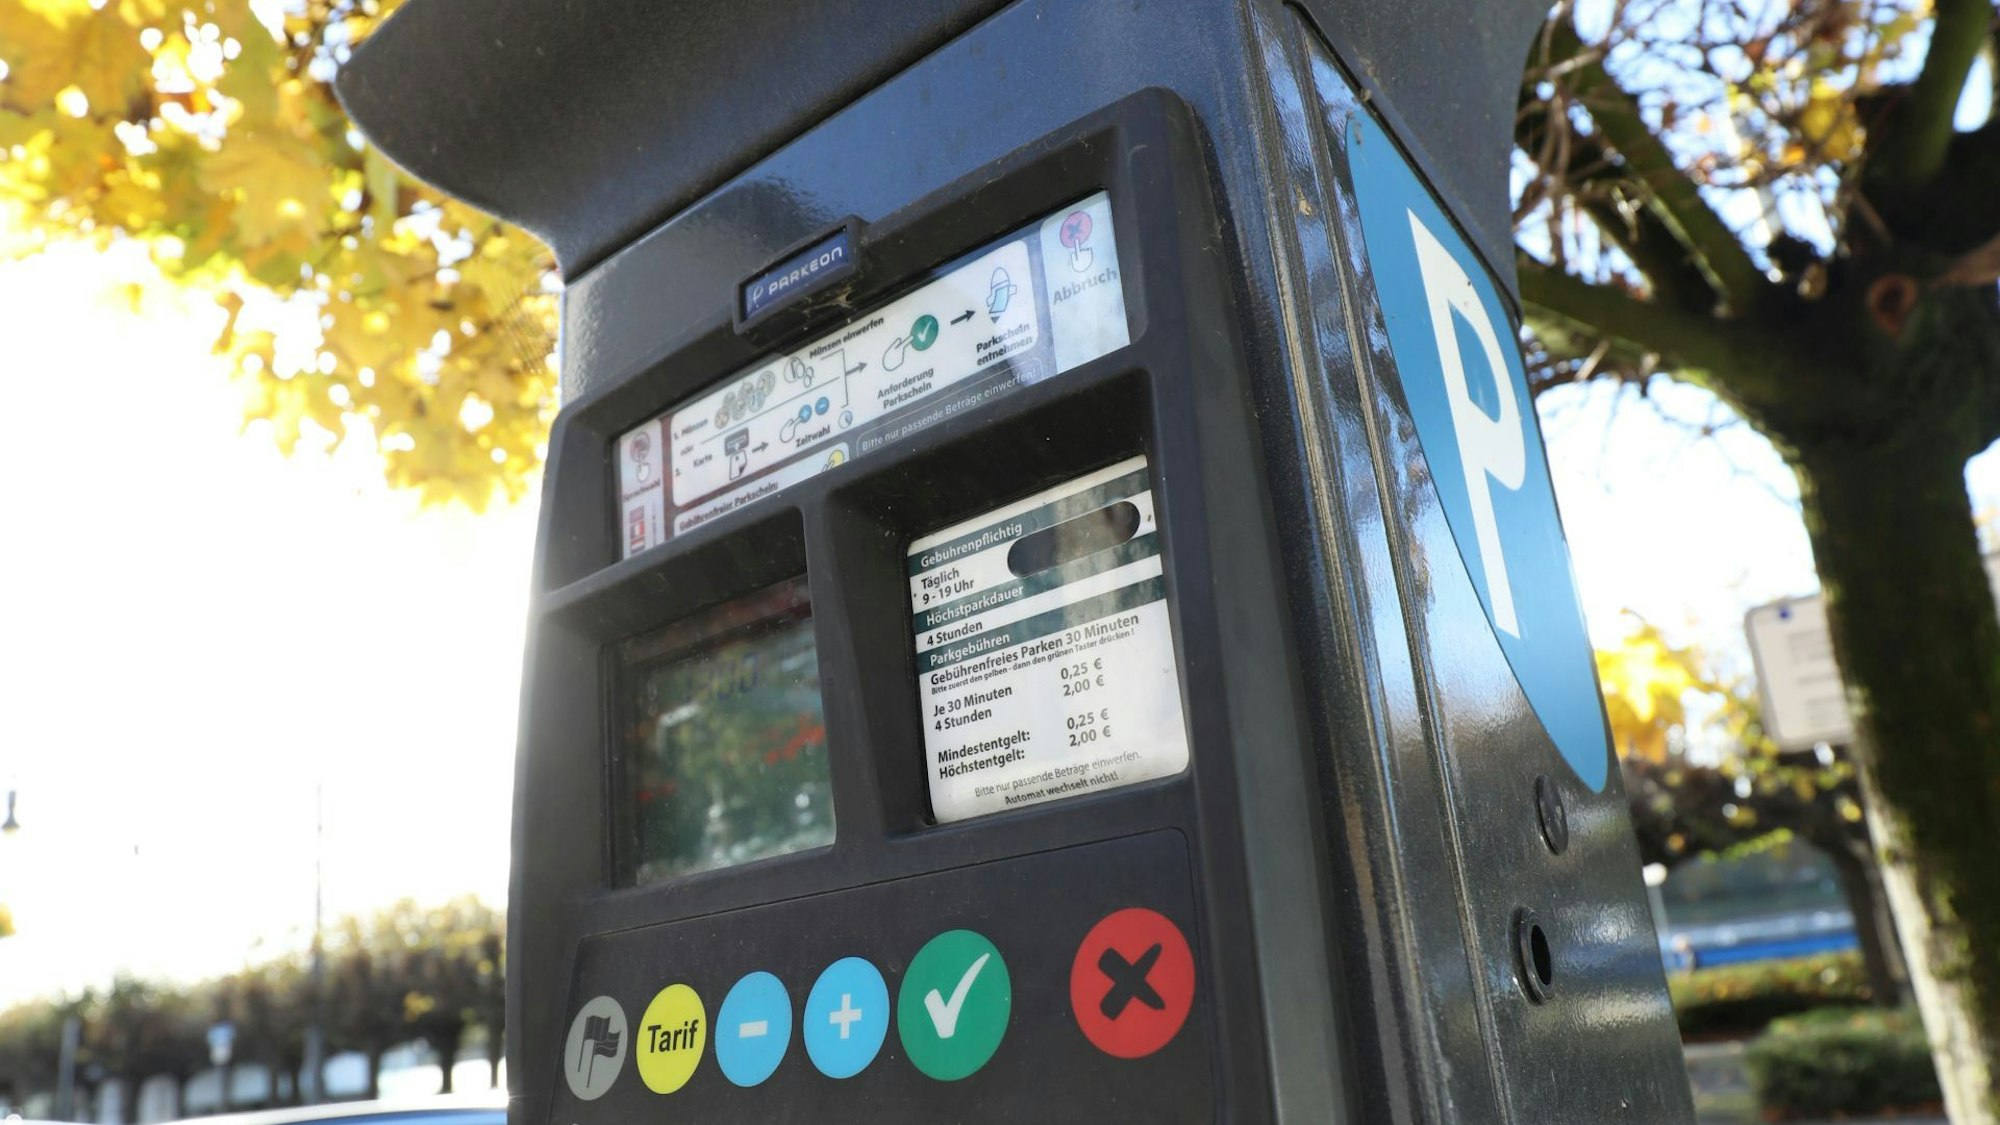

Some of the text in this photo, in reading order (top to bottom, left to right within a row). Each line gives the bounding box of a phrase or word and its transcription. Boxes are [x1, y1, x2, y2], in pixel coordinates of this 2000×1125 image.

[768, 246, 843, 295] PARKEON
[1053, 267, 1118, 306] Abbruch
[842, 316, 885, 342] einwerfen
[976, 323, 1030, 353] Parkschein
[976, 336, 1033, 366] entnehmen
[877, 368, 934, 400] Anforderung
[883, 382, 932, 410] Parkschein
[861, 436, 883, 452] Bitte
[884, 430, 899, 441] nur
[901, 411, 944, 436] passende
[984, 367, 1037, 398] einwerfen!
[1406, 207, 1527, 639] P
[795, 424, 831, 448] Zeitwahl
[920, 567, 960, 589] Täglich
[922, 593, 930, 605] 9
[938, 585, 952, 599] 19
[953, 579, 975, 594] Uhr
[926, 585, 1024, 627] Höchstparkdauer
[926, 621, 983, 647] 4 Stunden
[930, 614, 1140, 685] Gebührenfreies Parken 30 Minuten
[930, 633, 1010, 667] Parkgebühren
[931, 684, 947, 695] Bitte
[948, 678, 969, 691] zuerst
[969, 673, 983, 684] den
[983, 667, 1008, 681] gelben
[1012, 660, 1031, 671] dann
[1032, 656, 1046, 665] den
[1047, 647, 1074, 662] grünen
[1074, 640, 1098, 653] Taster
[1098, 630, 1131, 645] drücken
[1060, 657, 1103, 680] 0,25 €
[933, 685, 1013, 717] Je 30 Minuten
[1062, 674, 1105, 697] 2,00 €
[935, 708, 993, 732] 4 Stunden
[1066, 708, 1109, 730] 0,25 €
[938, 729, 1031, 764] Mindestentgelt:
[1069, 724, 1112, 747] 2,00 €
[939, 748, 1025, 780] Höchstentgelt:
[974, 785, 995, 798] Bitte
[996, 782, 1011, 793] nur
[1012, 771, 1054, 791] passende
[1054, 762, 1090, 779] Beträge
[1004, 770, 1119, 806] Automat wechselt nicht!
[647, 1019, 699, 1054] Tarif
